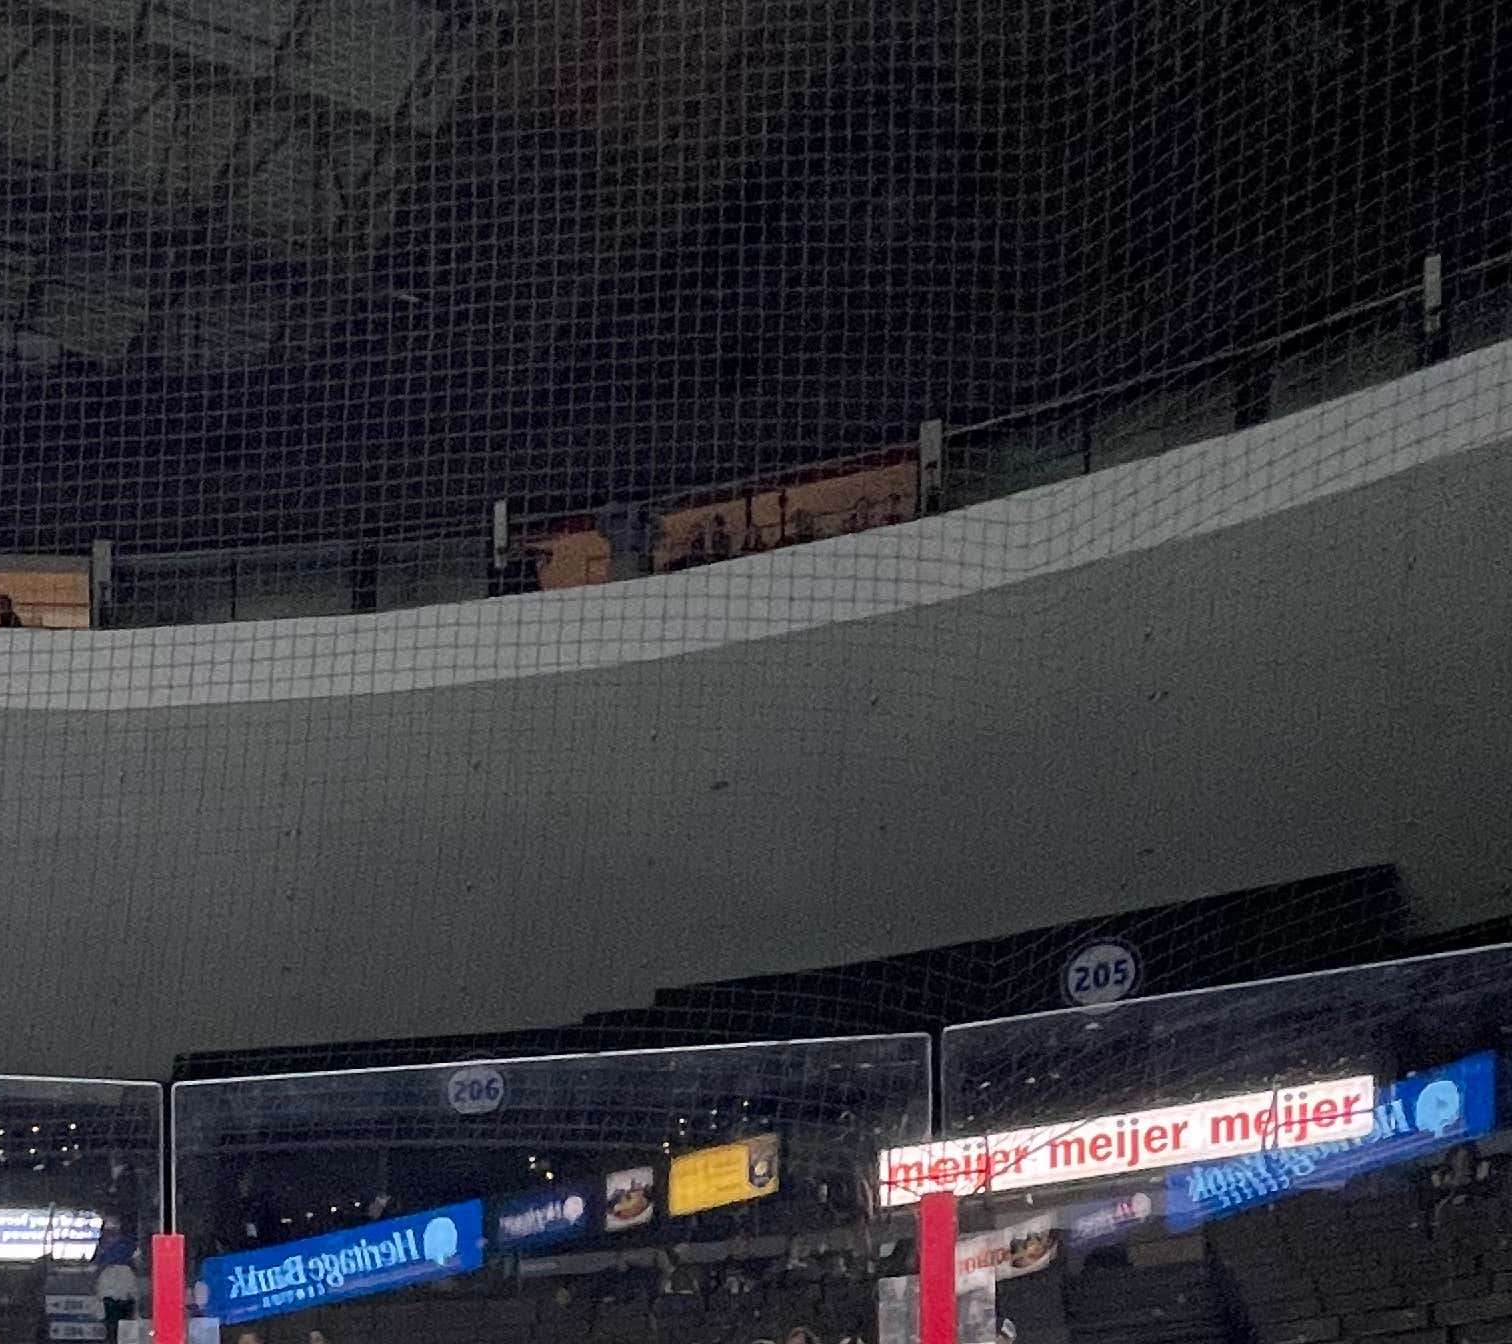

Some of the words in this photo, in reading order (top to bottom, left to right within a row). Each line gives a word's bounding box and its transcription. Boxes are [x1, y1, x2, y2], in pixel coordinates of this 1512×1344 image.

[1075, 960, 1129, 993] 205
[454, 1077, 500, 1103] 206
[890, 1143, 1030, 1189] meijer
[1048, 1118, 1189, 1168] meijer
[1210, 1091, 1361, 1144] meijer
